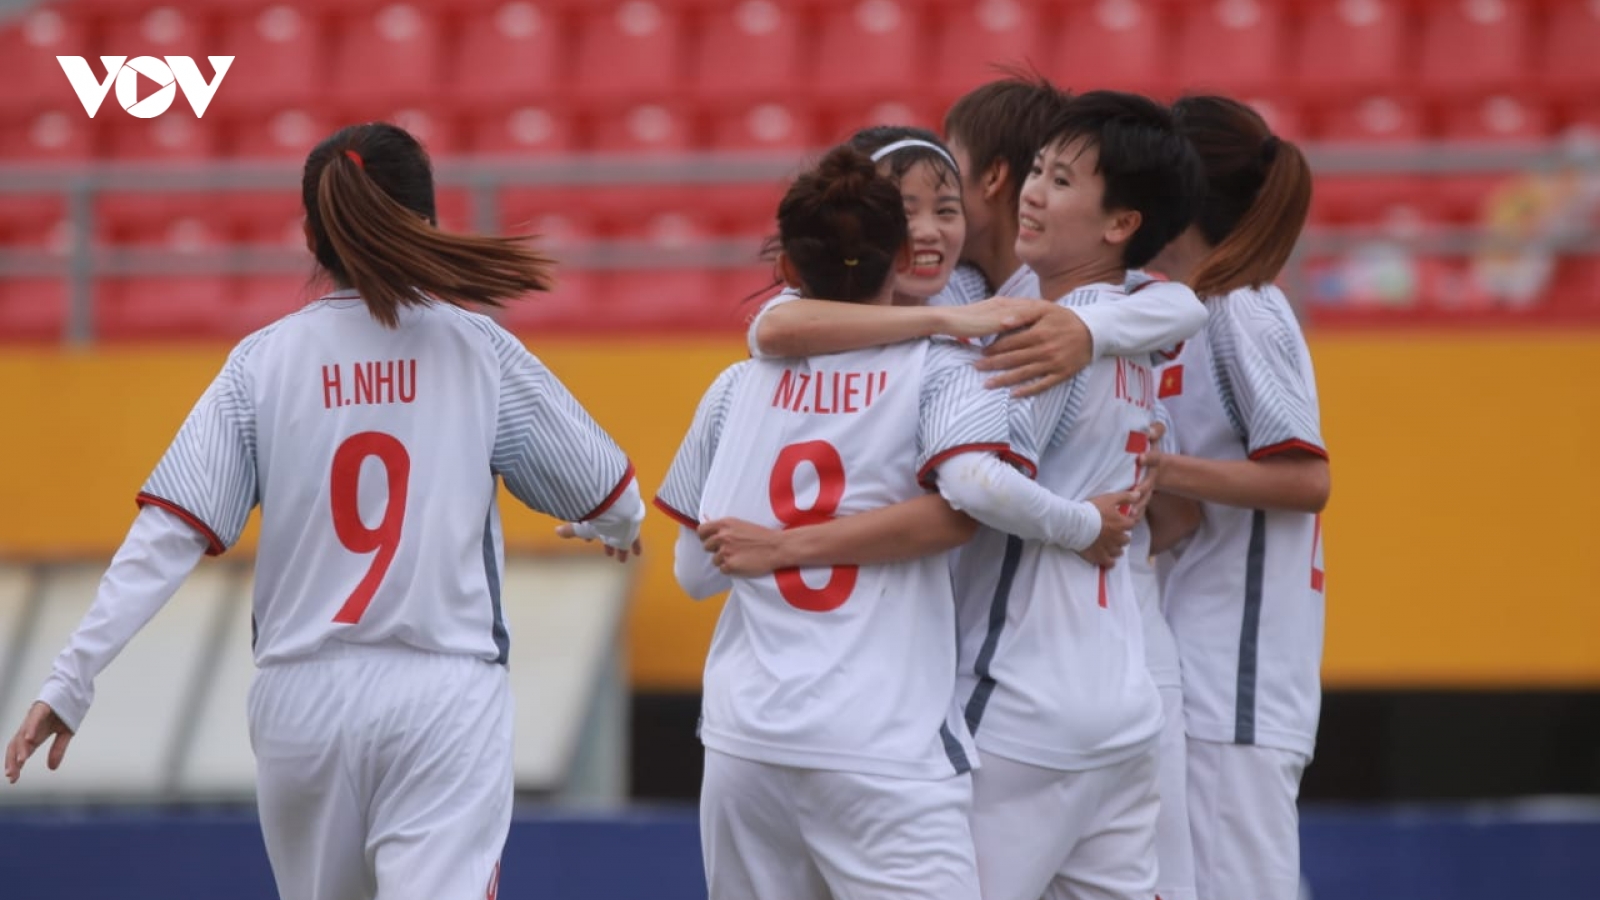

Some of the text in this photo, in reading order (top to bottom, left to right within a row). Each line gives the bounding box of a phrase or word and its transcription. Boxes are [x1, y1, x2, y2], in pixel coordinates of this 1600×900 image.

[321, 358, 417, 409] H.NHU
[330, 430, 411, 625] 9
[768, 438, 860, 613] 8
